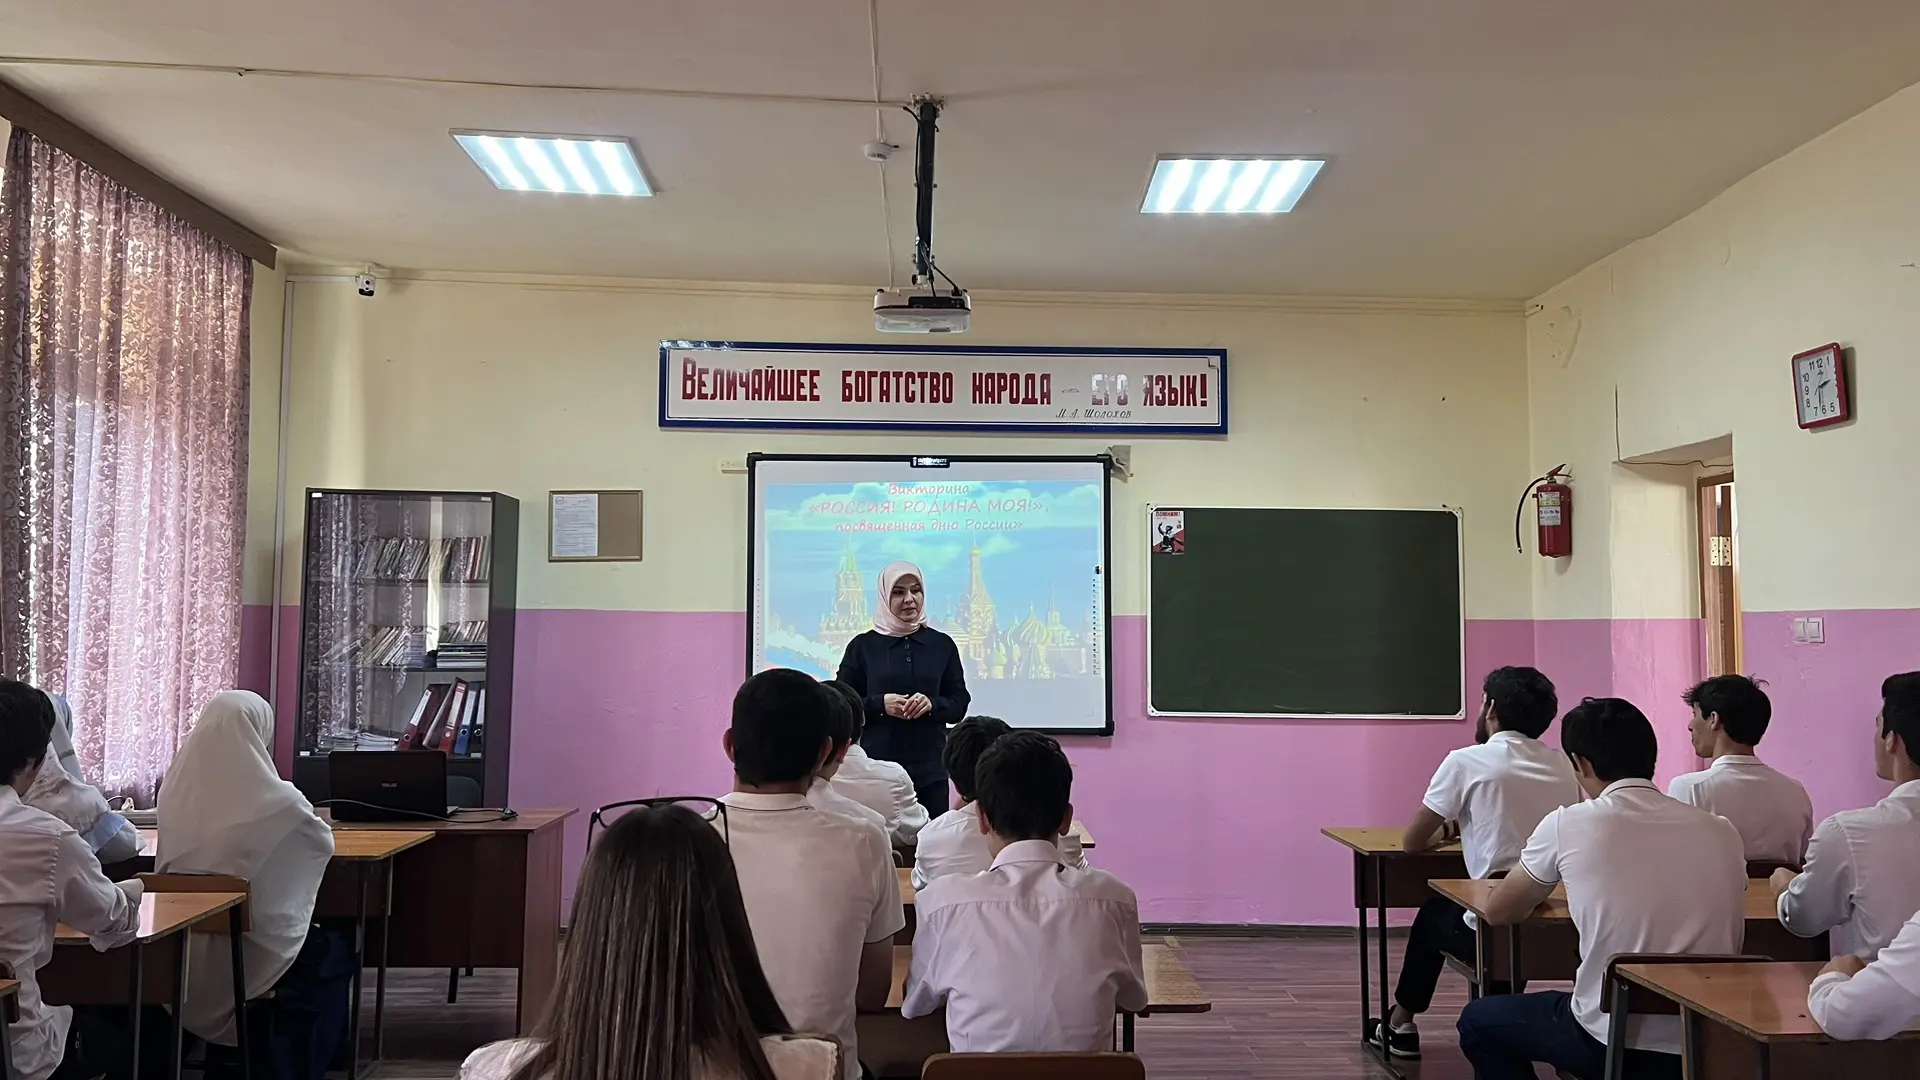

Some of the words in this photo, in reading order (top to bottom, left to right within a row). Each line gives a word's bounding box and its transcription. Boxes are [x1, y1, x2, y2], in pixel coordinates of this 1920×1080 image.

[1809, 361, 1815, 370] 11
[1816, 358, 1823, 368] 12
[1803, 372, 1810, 382] 10
[842, 370, 953, 403] БОГАТСТВО
[972, 372, 1051, 404] НАРОДА
[1143, 373, 1207, 407] ЯЗЫК!
[1804, 385, 1809, 395] 9
[1806, 398, 1811, 408] 8
[1830, 402, 1835, 412] 5
[1813, 406, 1818, 416] 7
[1821, 404, 1826, 415] 6
[888, 483, 970, 499] Викторина
[903, 500, 981, 516] РОДИНА
[931, 518, 959, 531] дню
